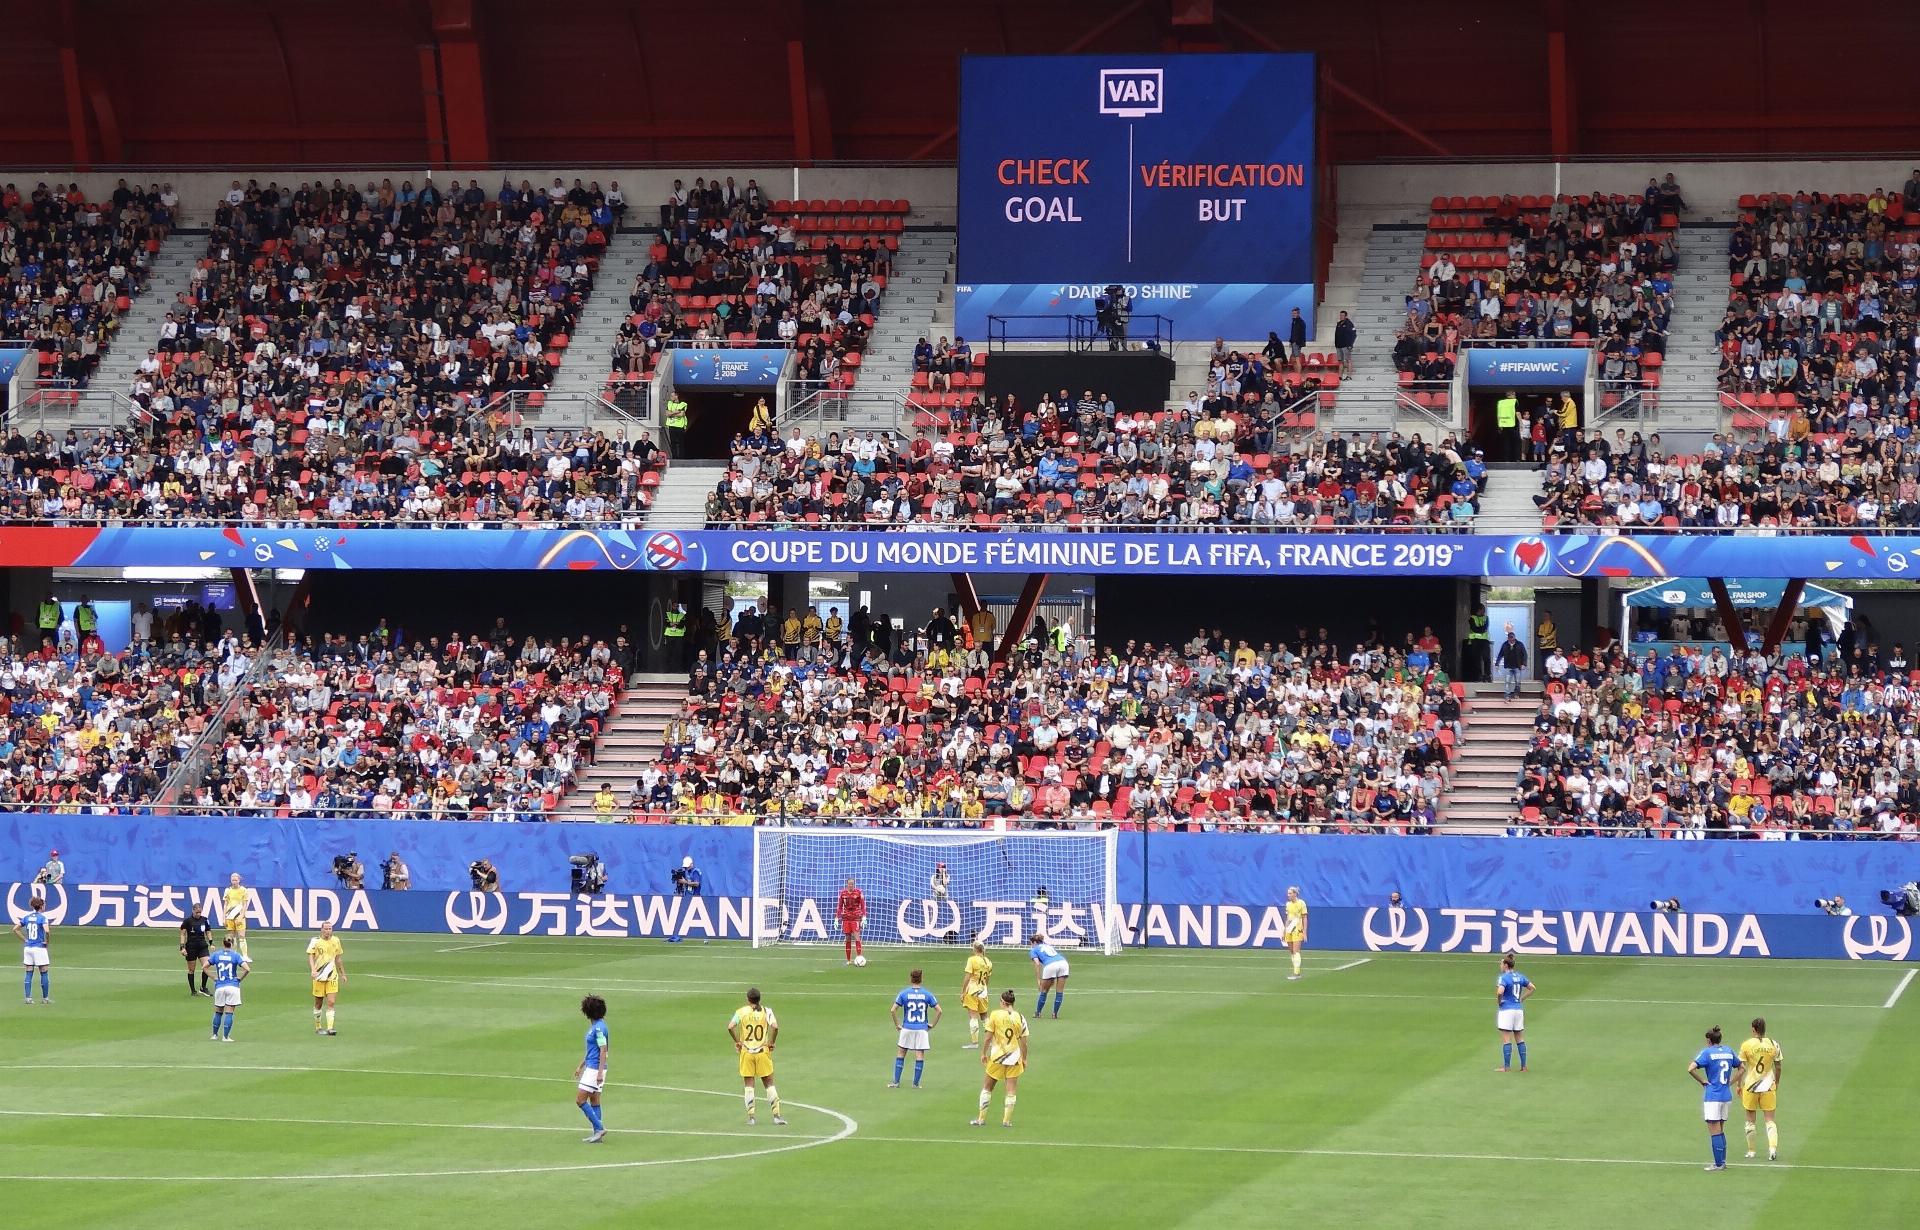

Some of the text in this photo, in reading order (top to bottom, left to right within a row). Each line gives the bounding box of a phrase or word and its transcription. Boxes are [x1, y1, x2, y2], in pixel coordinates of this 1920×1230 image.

[1107, 80, 1156, 102] VAR
[998, 158, 1090, 185] CHECK
[1141, 160, 1304, 187] VÉRIFICATION
[1004, 197, 1082, 222] GOAL
[1198, 199, 1247, 222] BUT
[1500, 362, 1559, 372] #FIFAWWC
[731, 540, 823, 564] COUPE
[831, 540, 868, 564] DU
[877, 541, 978, 566] MONDE
[984, 537, 1117, 566] FÉMININE
[1124, 542, 1160, 566] DE
[1167, 542, 1200, 566] LA
[1208, 543, 1271, 569] FIFA,
[1277, 543, 1386, 569] FRANCE
[78, 884, 186, 928] 万达
[188, 887, 380, 930] WANDA
[518, 892, 629, 938] 万达
[633, 896, 828, 939] WANDA
[26, 922, 38, 940] 18
[972, 902, 1088, 947] 万达
[1091, 904, 1288, 948] WANDA
[1440, 908, 1558, 955] 万达
[1562, 911, 1771, 957] WANDA
[218, 962, 233, 981] 21
[907, 1001, 926, 1023] 23
[745, 1024, 764, 1041] 20
[1004, 1027, 1014, 1045] 9
[1719, 1060, 1730, 1085] 2
[1755, 1056, 1765, 1075] 6
